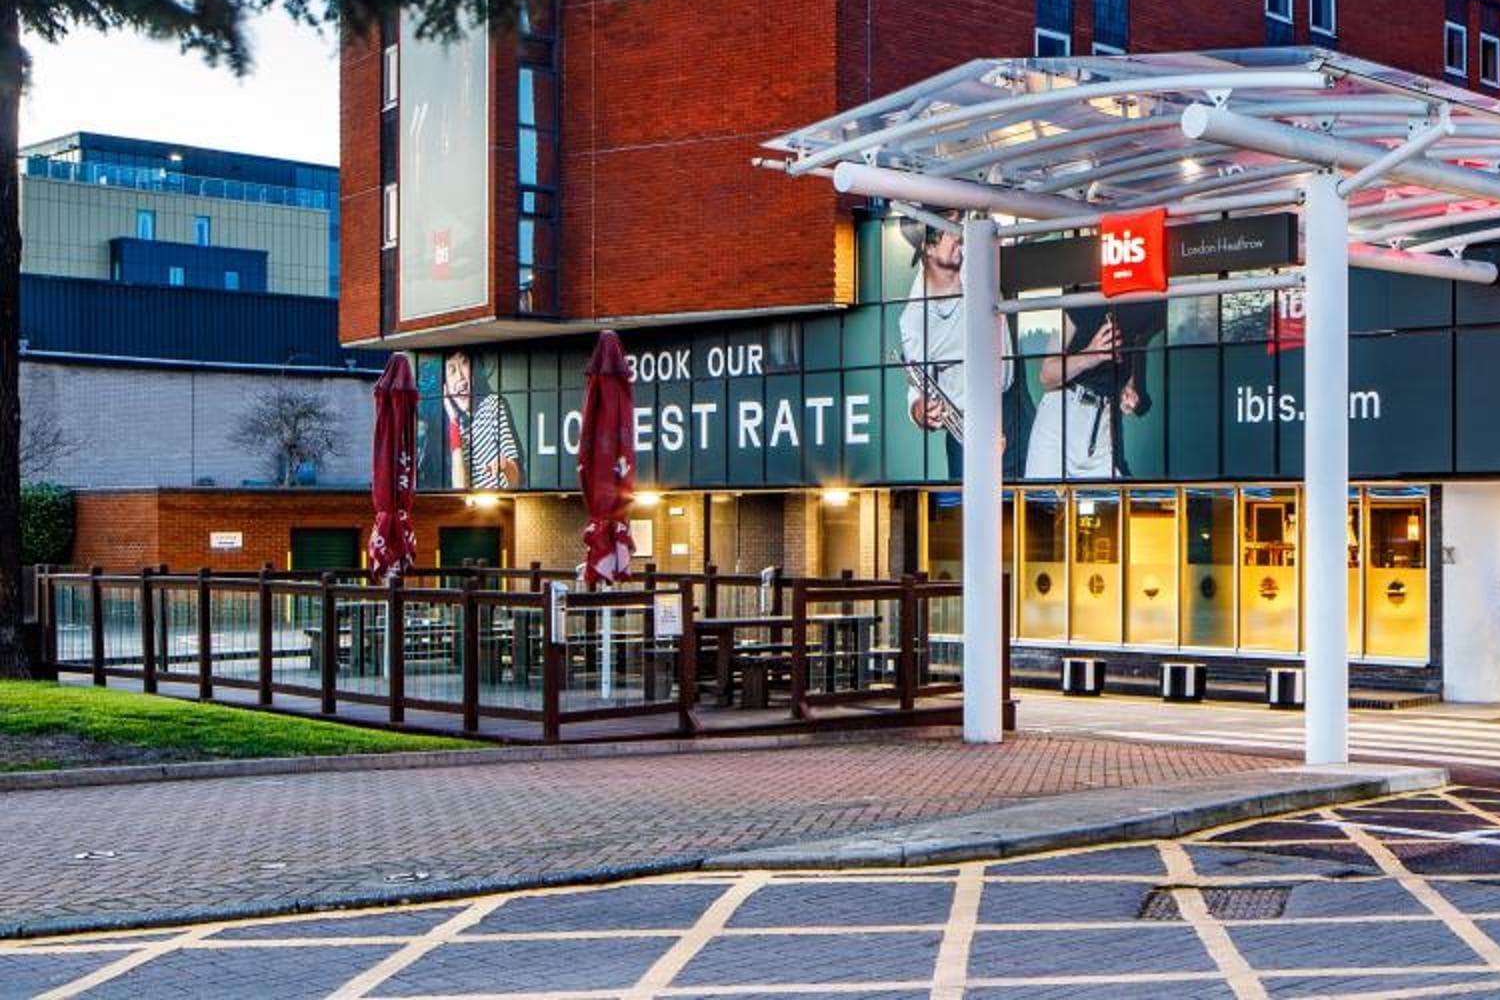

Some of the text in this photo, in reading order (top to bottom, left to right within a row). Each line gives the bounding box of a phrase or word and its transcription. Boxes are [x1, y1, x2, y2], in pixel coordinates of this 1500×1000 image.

[1102, 229, 1146, 267] ibis
[1181, 238, 1217, 257] London
[624, 344, 764, 383] BOOK OUR
[1236, 384, 1381, 424] ibis.m
[536, 394, 870, 455] LOEST RATE
